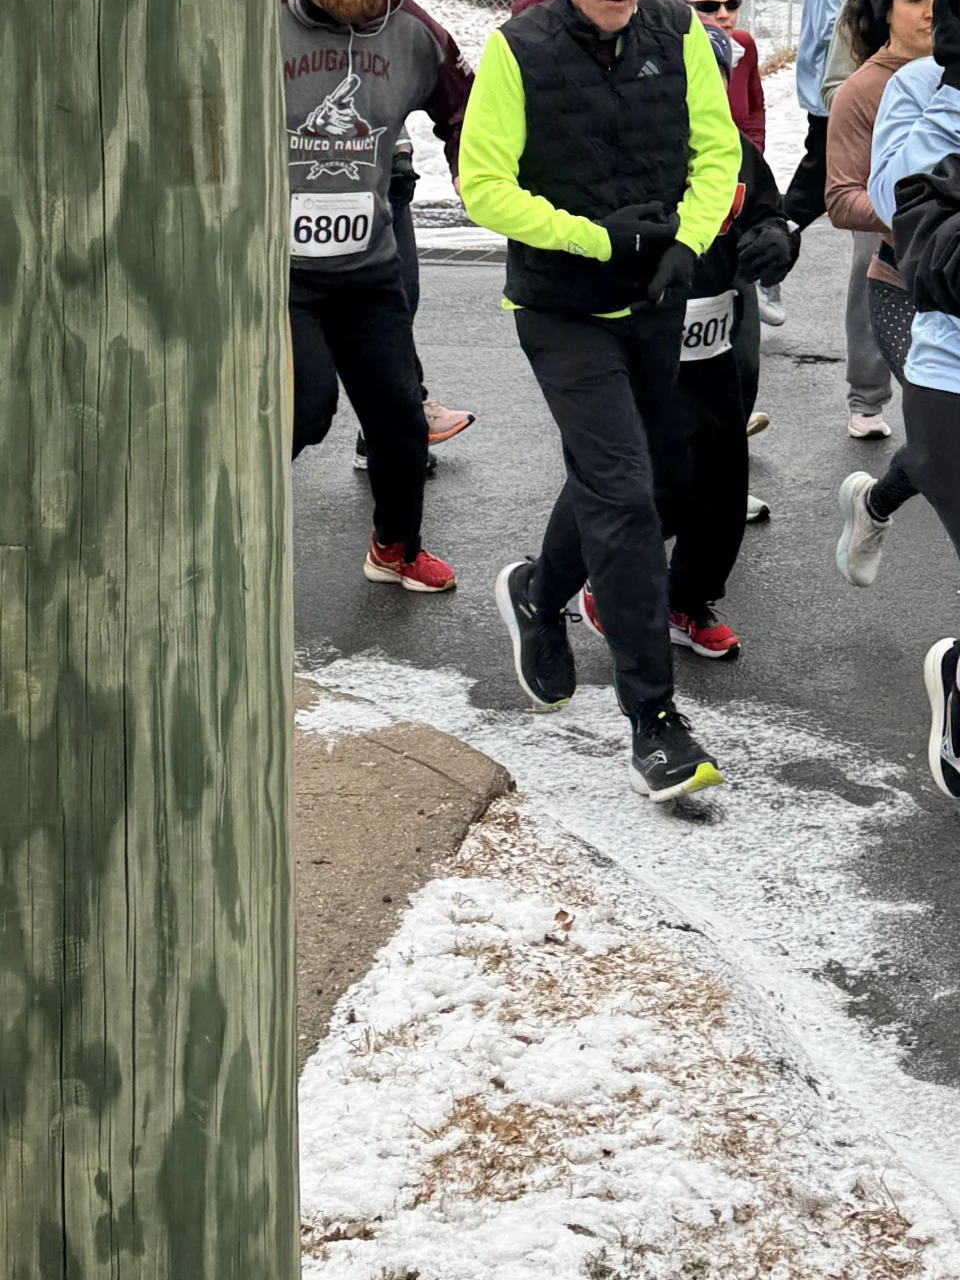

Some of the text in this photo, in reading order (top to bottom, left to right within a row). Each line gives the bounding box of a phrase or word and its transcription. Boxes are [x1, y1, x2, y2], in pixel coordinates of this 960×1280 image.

[284, 48, 391, 81] NAUGATUCK
[294, 214, 369, 244] 6800
[681, 313, 728, 348] 801
